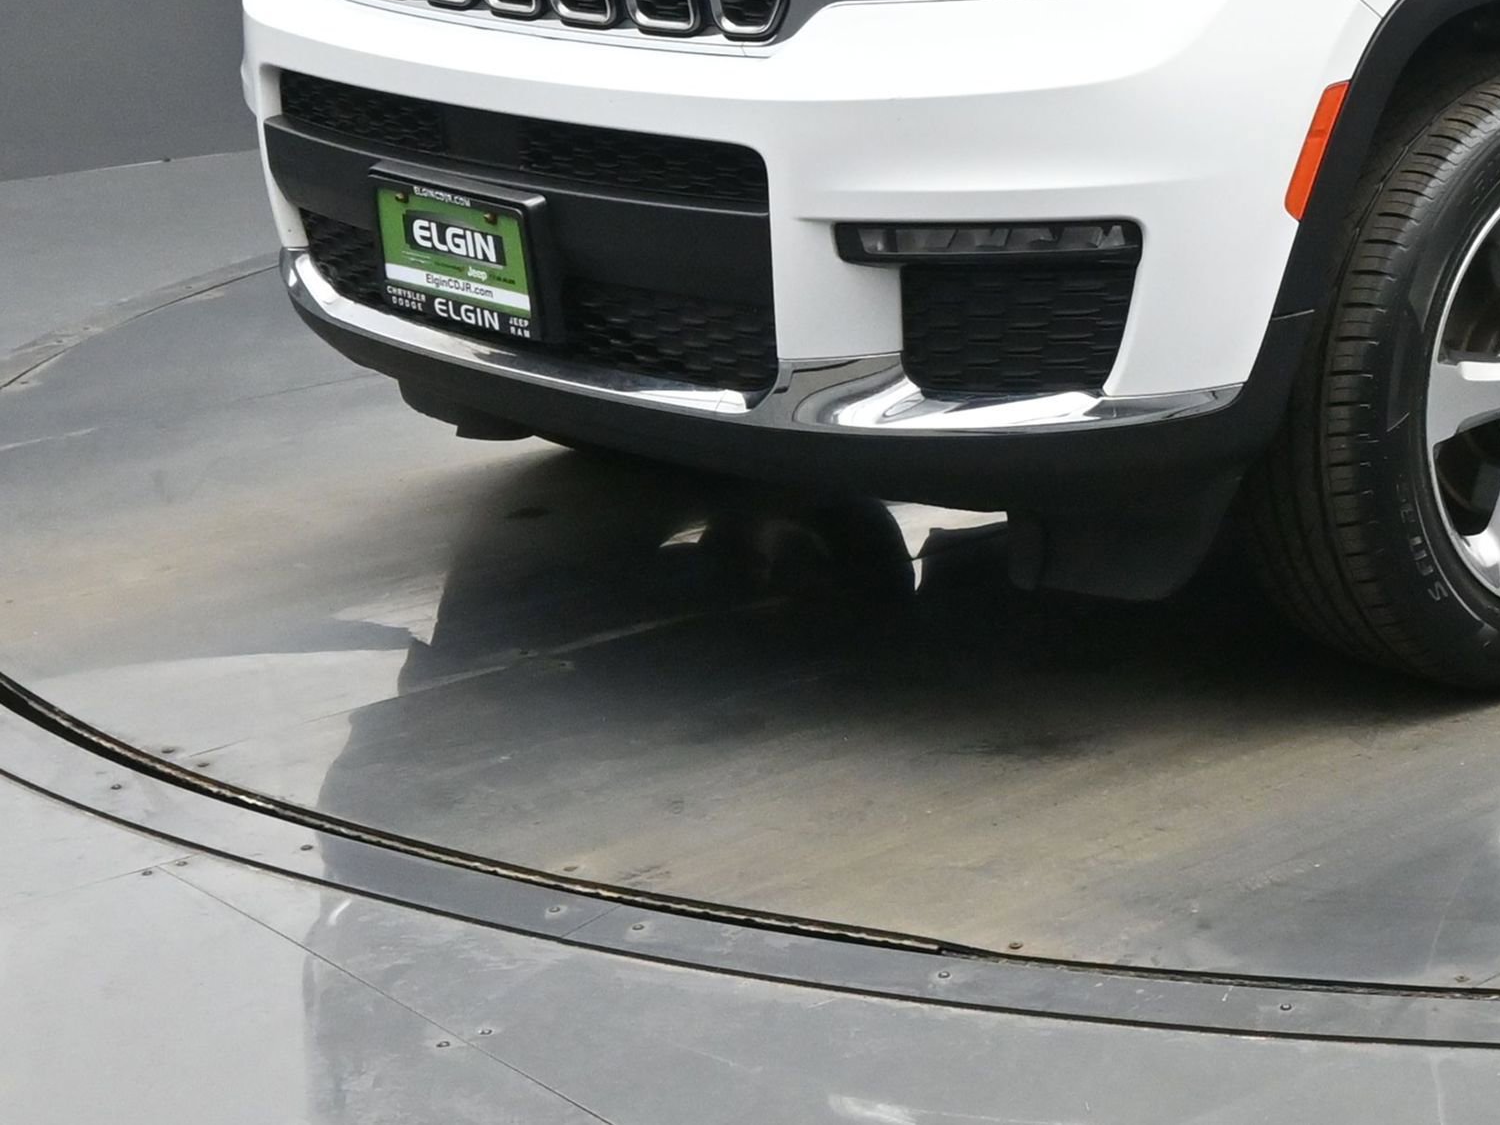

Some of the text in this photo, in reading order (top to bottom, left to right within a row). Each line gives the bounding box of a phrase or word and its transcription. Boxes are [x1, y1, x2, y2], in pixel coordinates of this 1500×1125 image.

[412, 219, 497, 262] ELGIN
[386, 285, 426, 302] CHRYSLER
[425, 273, 494, 298] ElginCDJR.com
[392, 296, 423, 311] DODGE
[434, 297, 500, 330] ELGIN
[509, 316, 529, 327] JEEP
[510, 326, 531, 339] RAM
